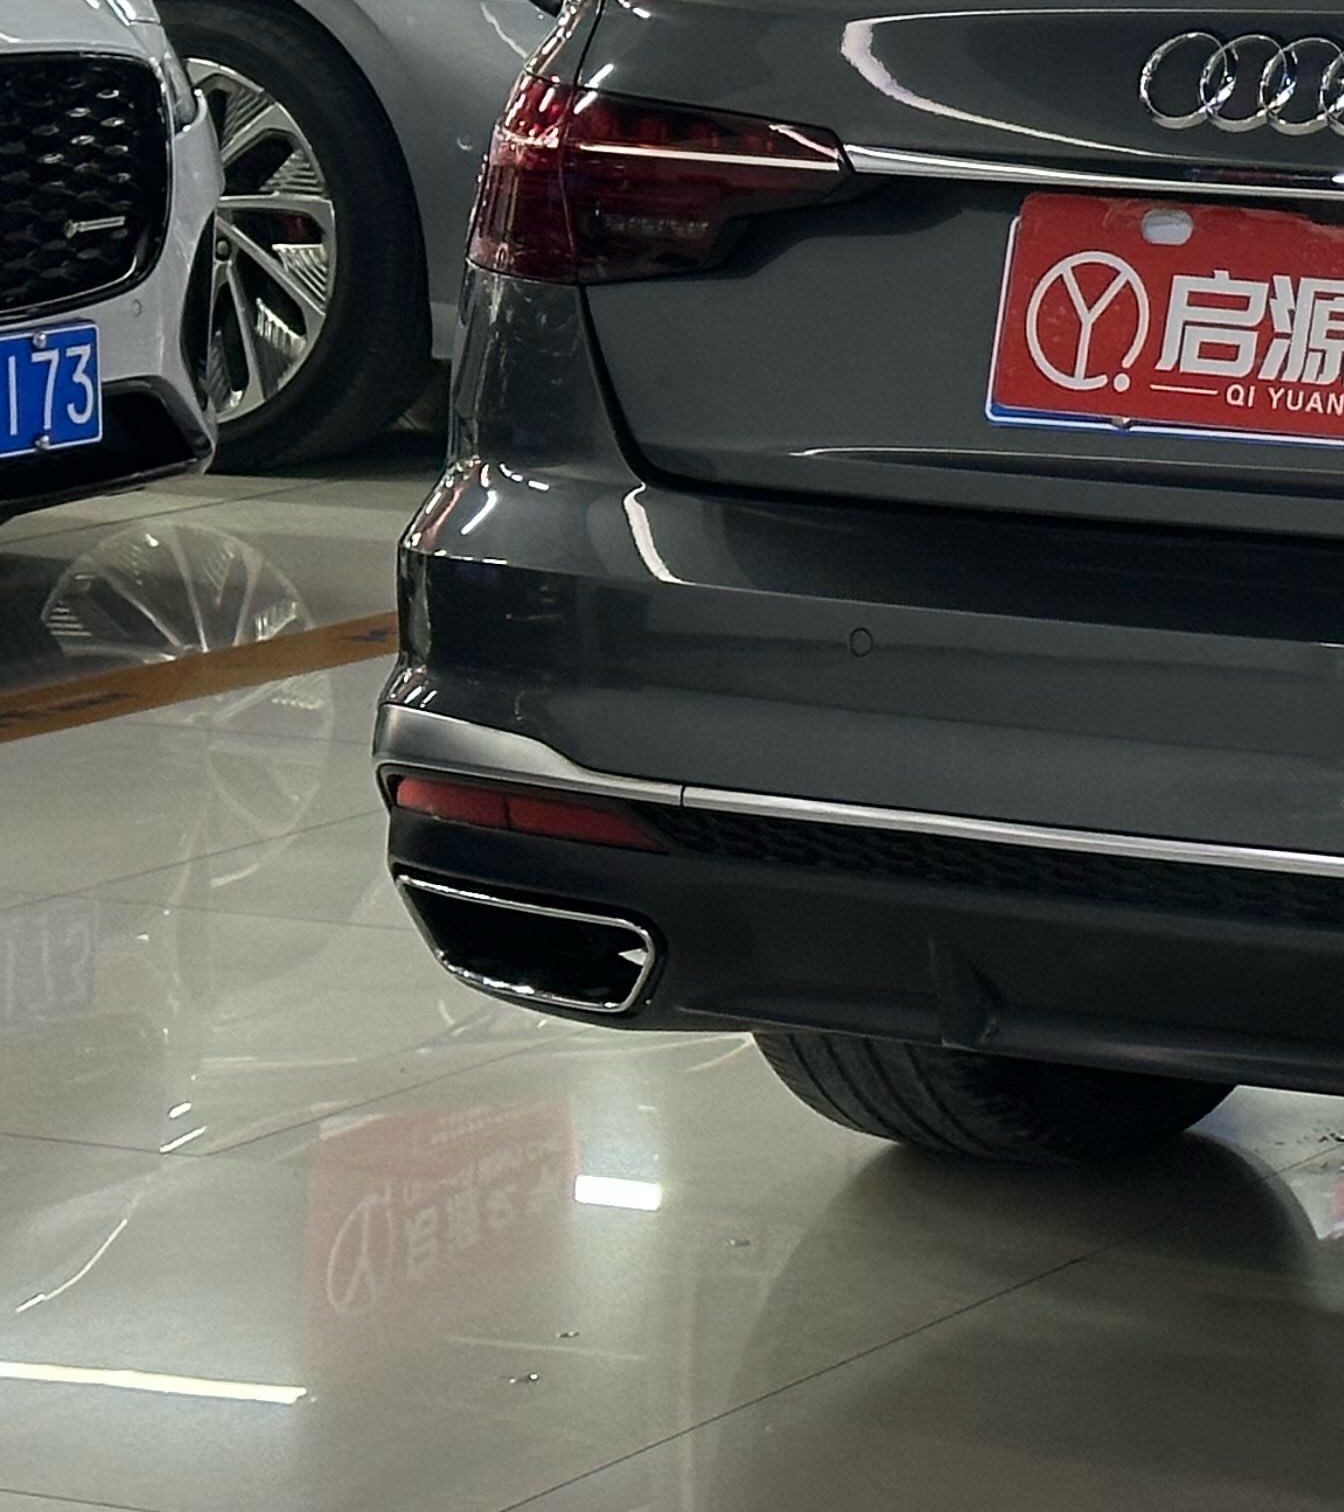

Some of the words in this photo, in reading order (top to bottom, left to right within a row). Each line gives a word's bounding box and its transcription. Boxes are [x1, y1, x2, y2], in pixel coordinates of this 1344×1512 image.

[7, 344, 94, 437] 173
[1225, 384, 1255, 408] QI
[1266, 387, 1344, 415] YUAN
